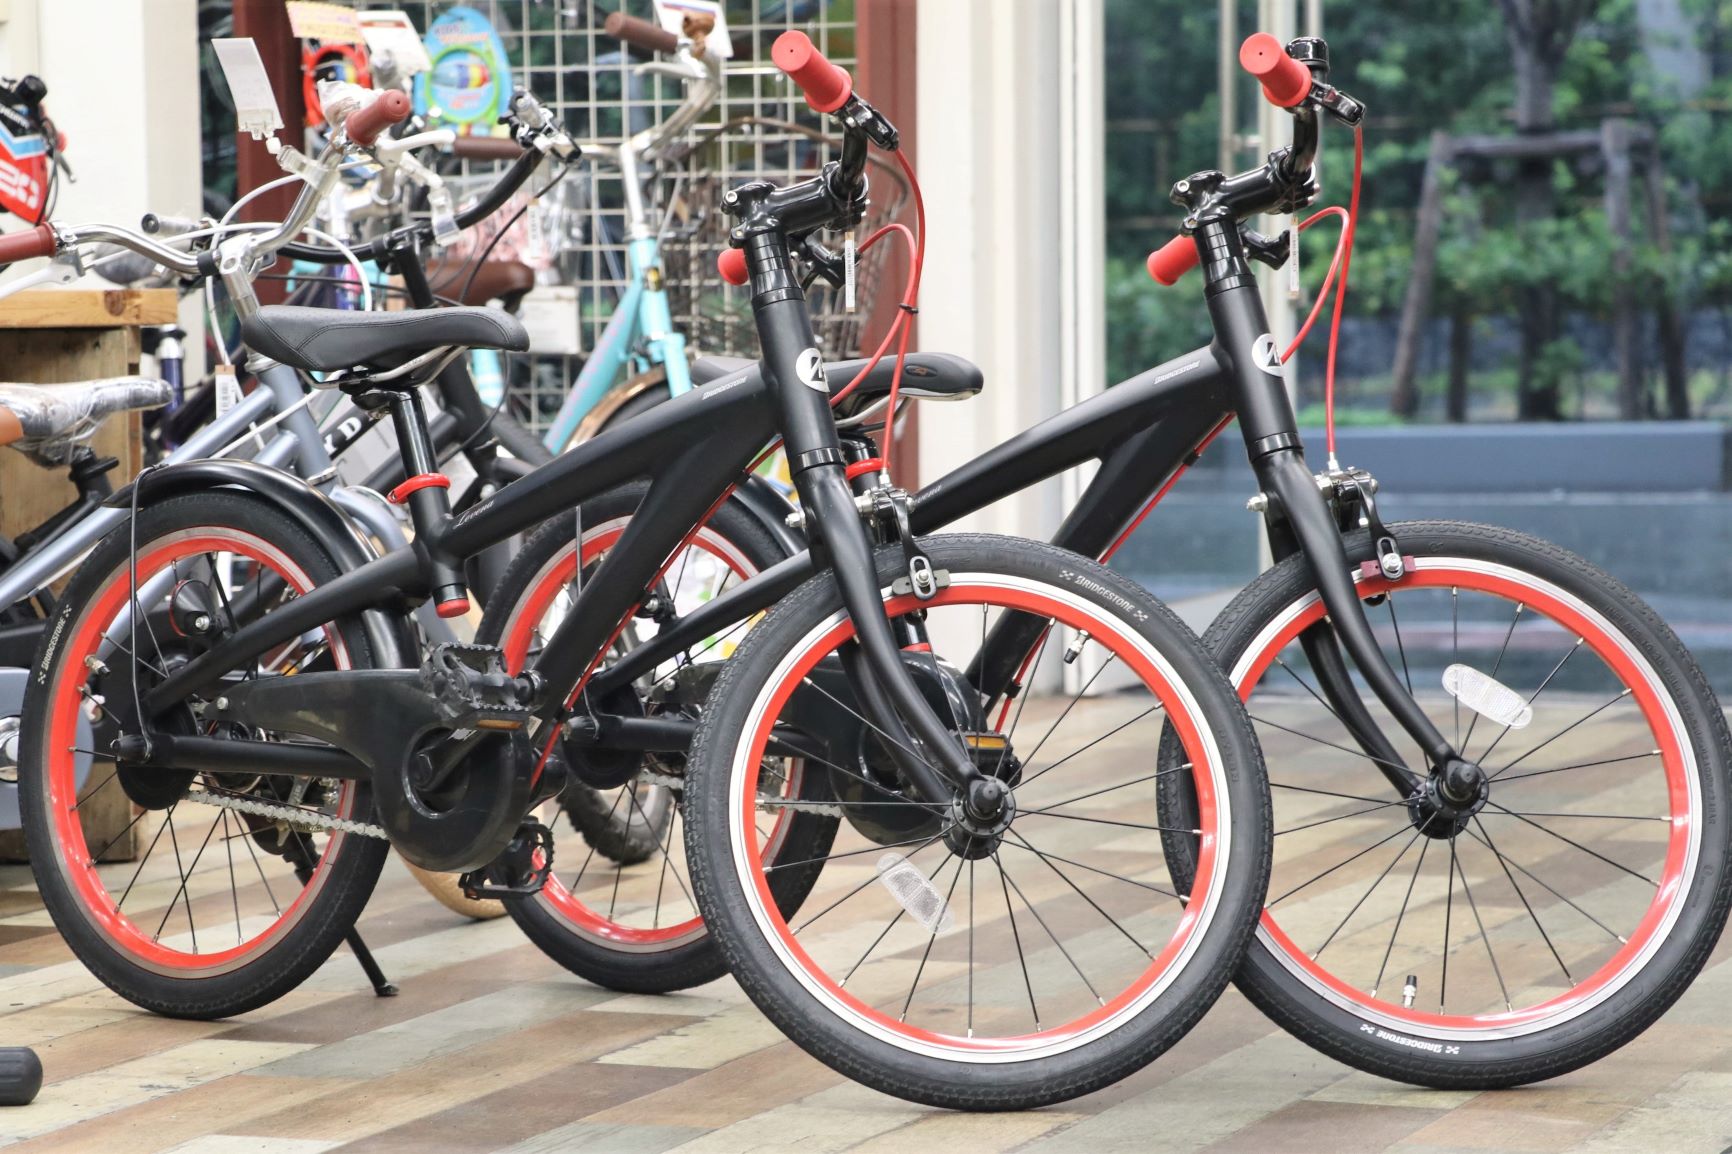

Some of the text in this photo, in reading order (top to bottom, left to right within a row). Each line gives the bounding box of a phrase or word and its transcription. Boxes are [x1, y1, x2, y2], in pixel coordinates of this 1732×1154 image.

[1074, 575, 1136, 613] BRIDGESTONE
[41, 616, 66, 672] BRIDGESTONE
[1376, 1029, 1443, 1054] BRIDGESTONE
